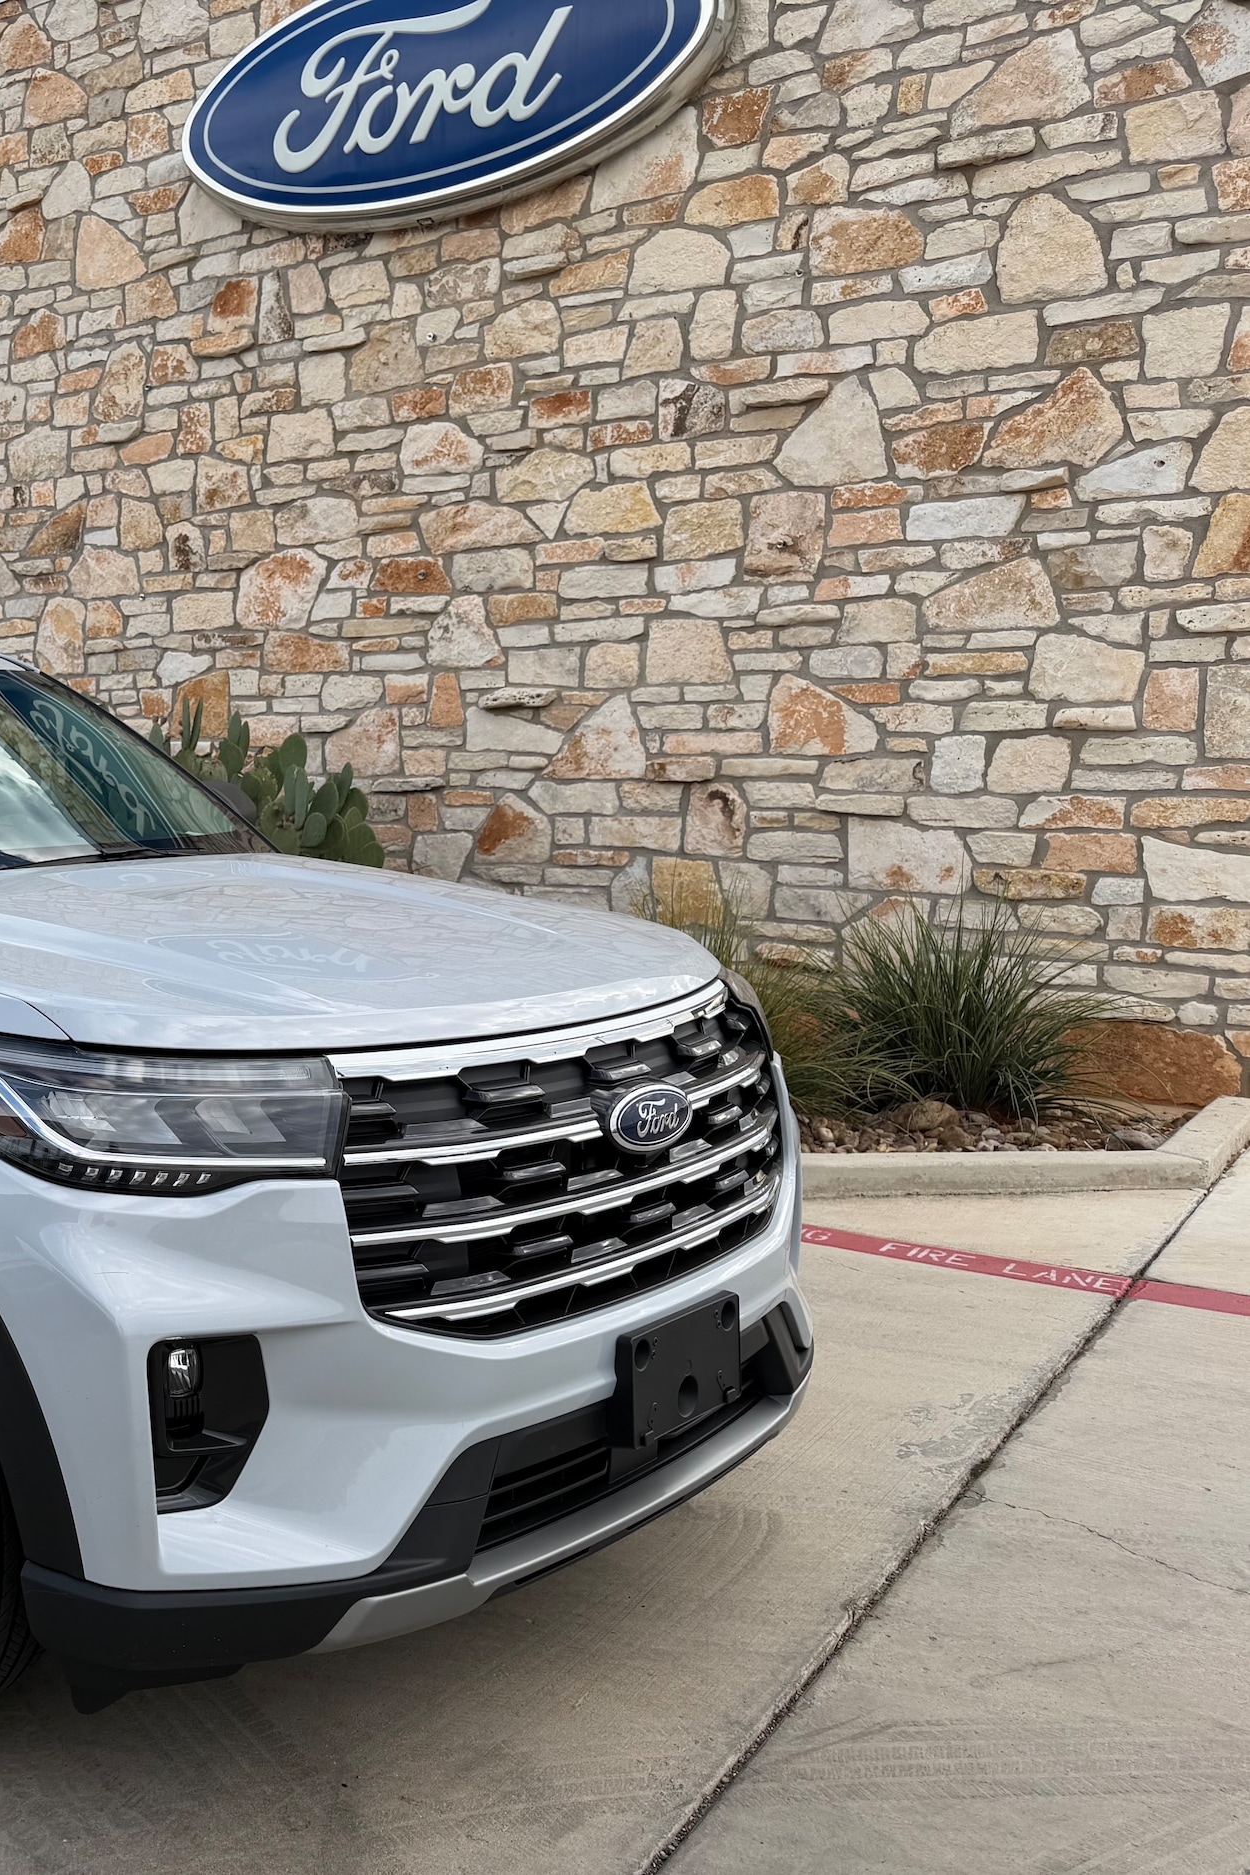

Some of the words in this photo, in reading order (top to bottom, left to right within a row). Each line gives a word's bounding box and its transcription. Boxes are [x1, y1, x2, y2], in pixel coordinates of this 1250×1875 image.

[273, 0, 574, 174] Ford
[636, 1098, 679, 1138] Ford
[879, 1242, 976, 1267] FIRE
[1002, 1263, 1124, 1293] LANE
